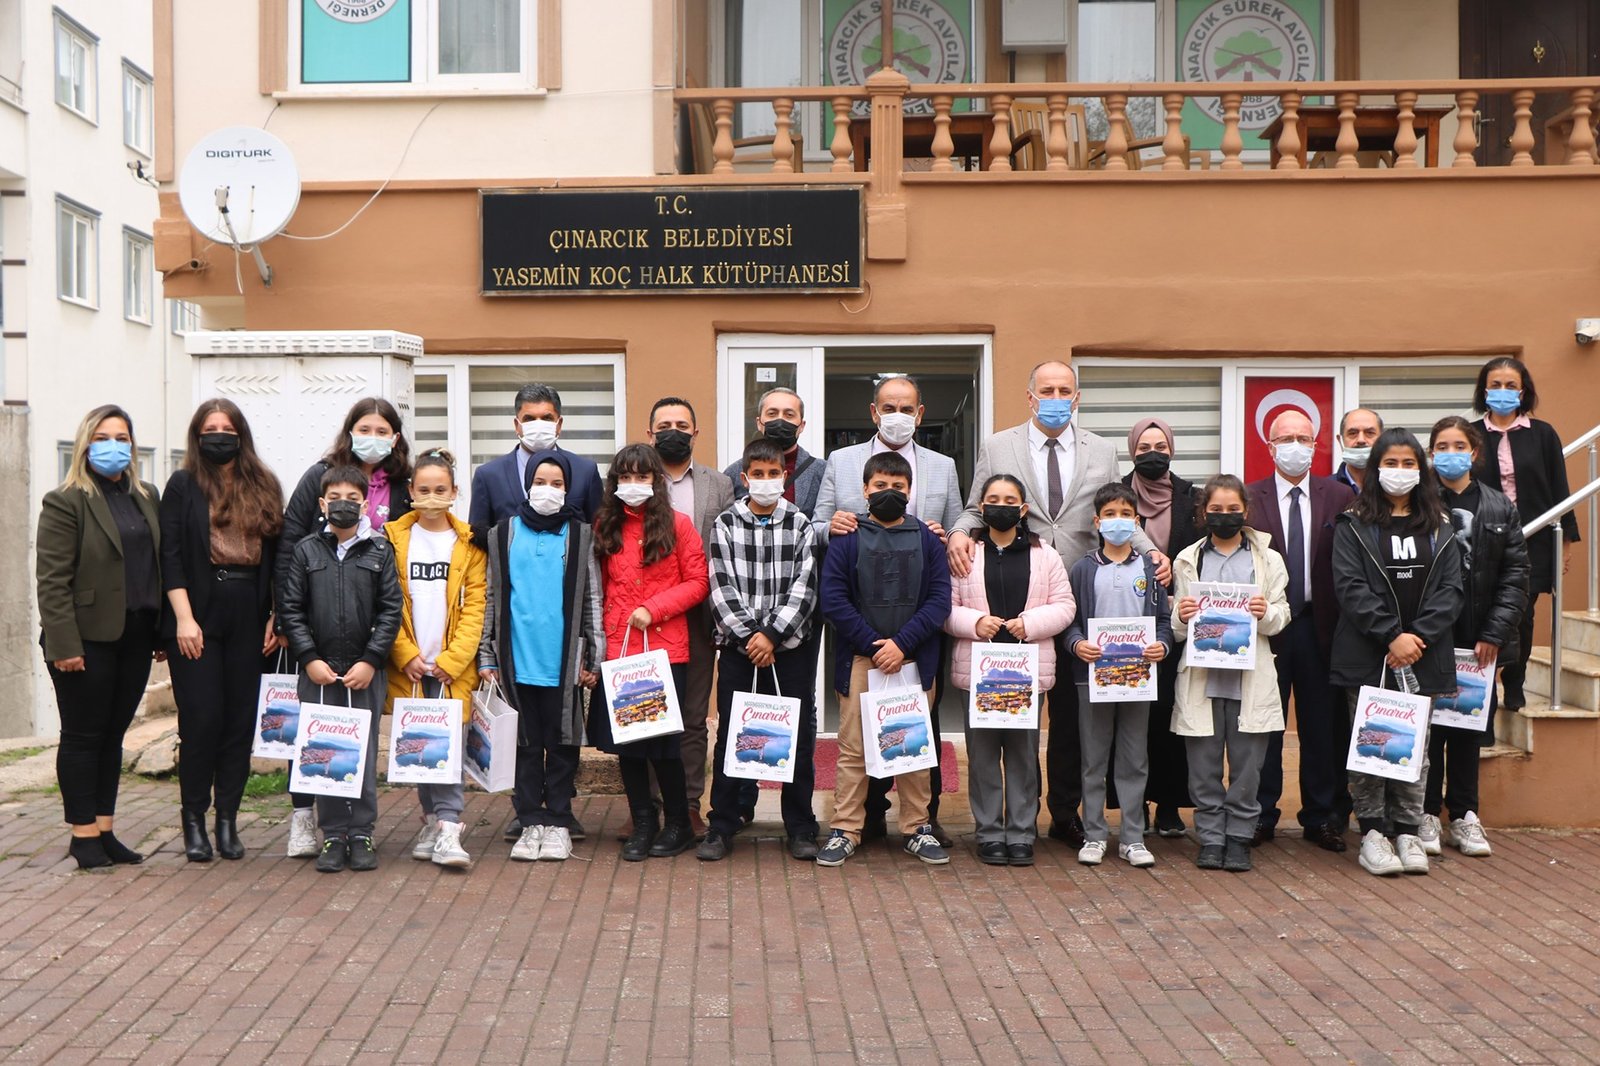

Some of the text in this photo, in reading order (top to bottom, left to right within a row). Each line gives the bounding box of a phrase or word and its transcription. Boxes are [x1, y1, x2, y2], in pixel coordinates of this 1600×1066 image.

[870, 0, 933, 19] SREK
[934, 18, 960, 84] AVCILA
[205, 149, 272, 158] DIGITURK
[549, 224, 793, 253] ÇINARCIK BELEDİYESİ
[493, 261, 850, 289] YASEMİN KOÇ HALK KÜTÜPHANESİ
[1396, 568, 1413, 579] mood
